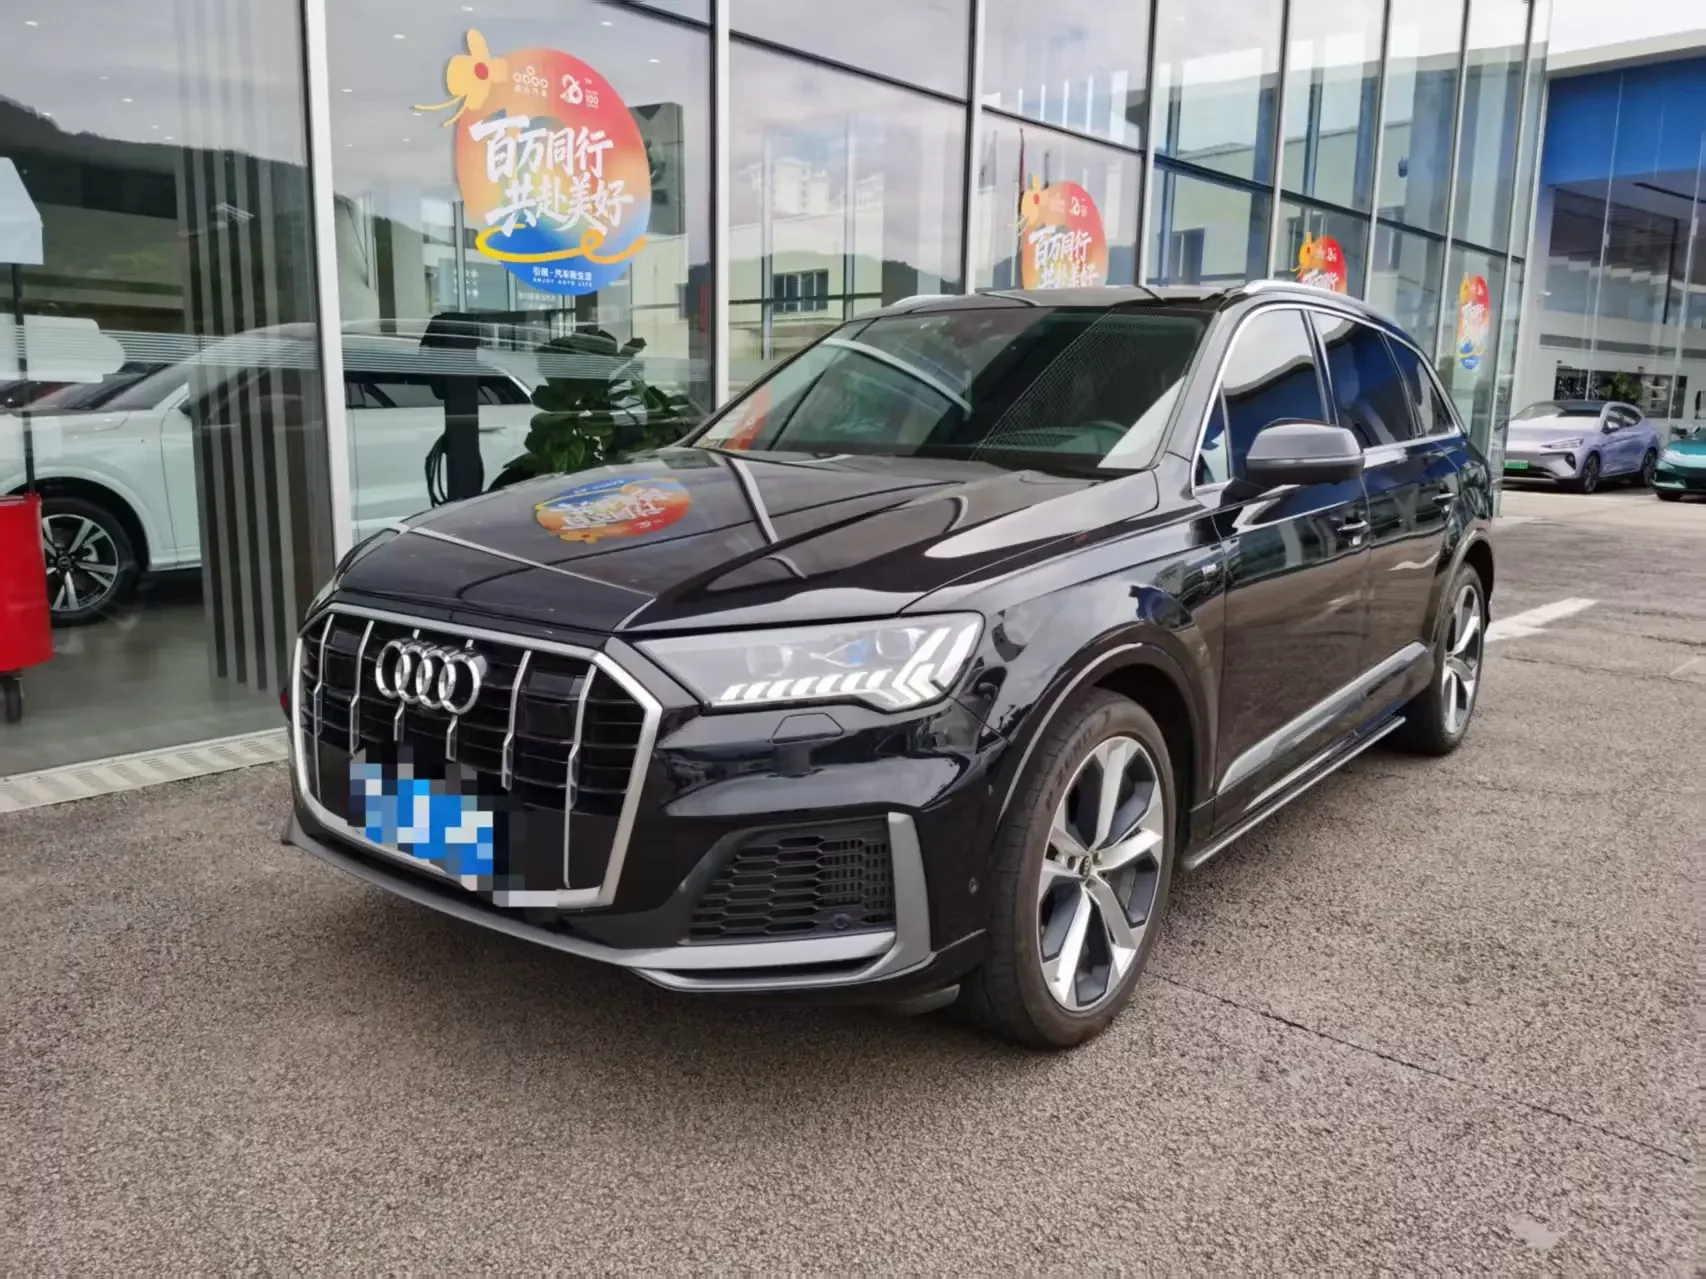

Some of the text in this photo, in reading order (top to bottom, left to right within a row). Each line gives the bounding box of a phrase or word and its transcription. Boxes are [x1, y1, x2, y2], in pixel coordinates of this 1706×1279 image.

[470, 116, 613, 182] 百万同行
[486, 173, 633, 236] 共赴美好
